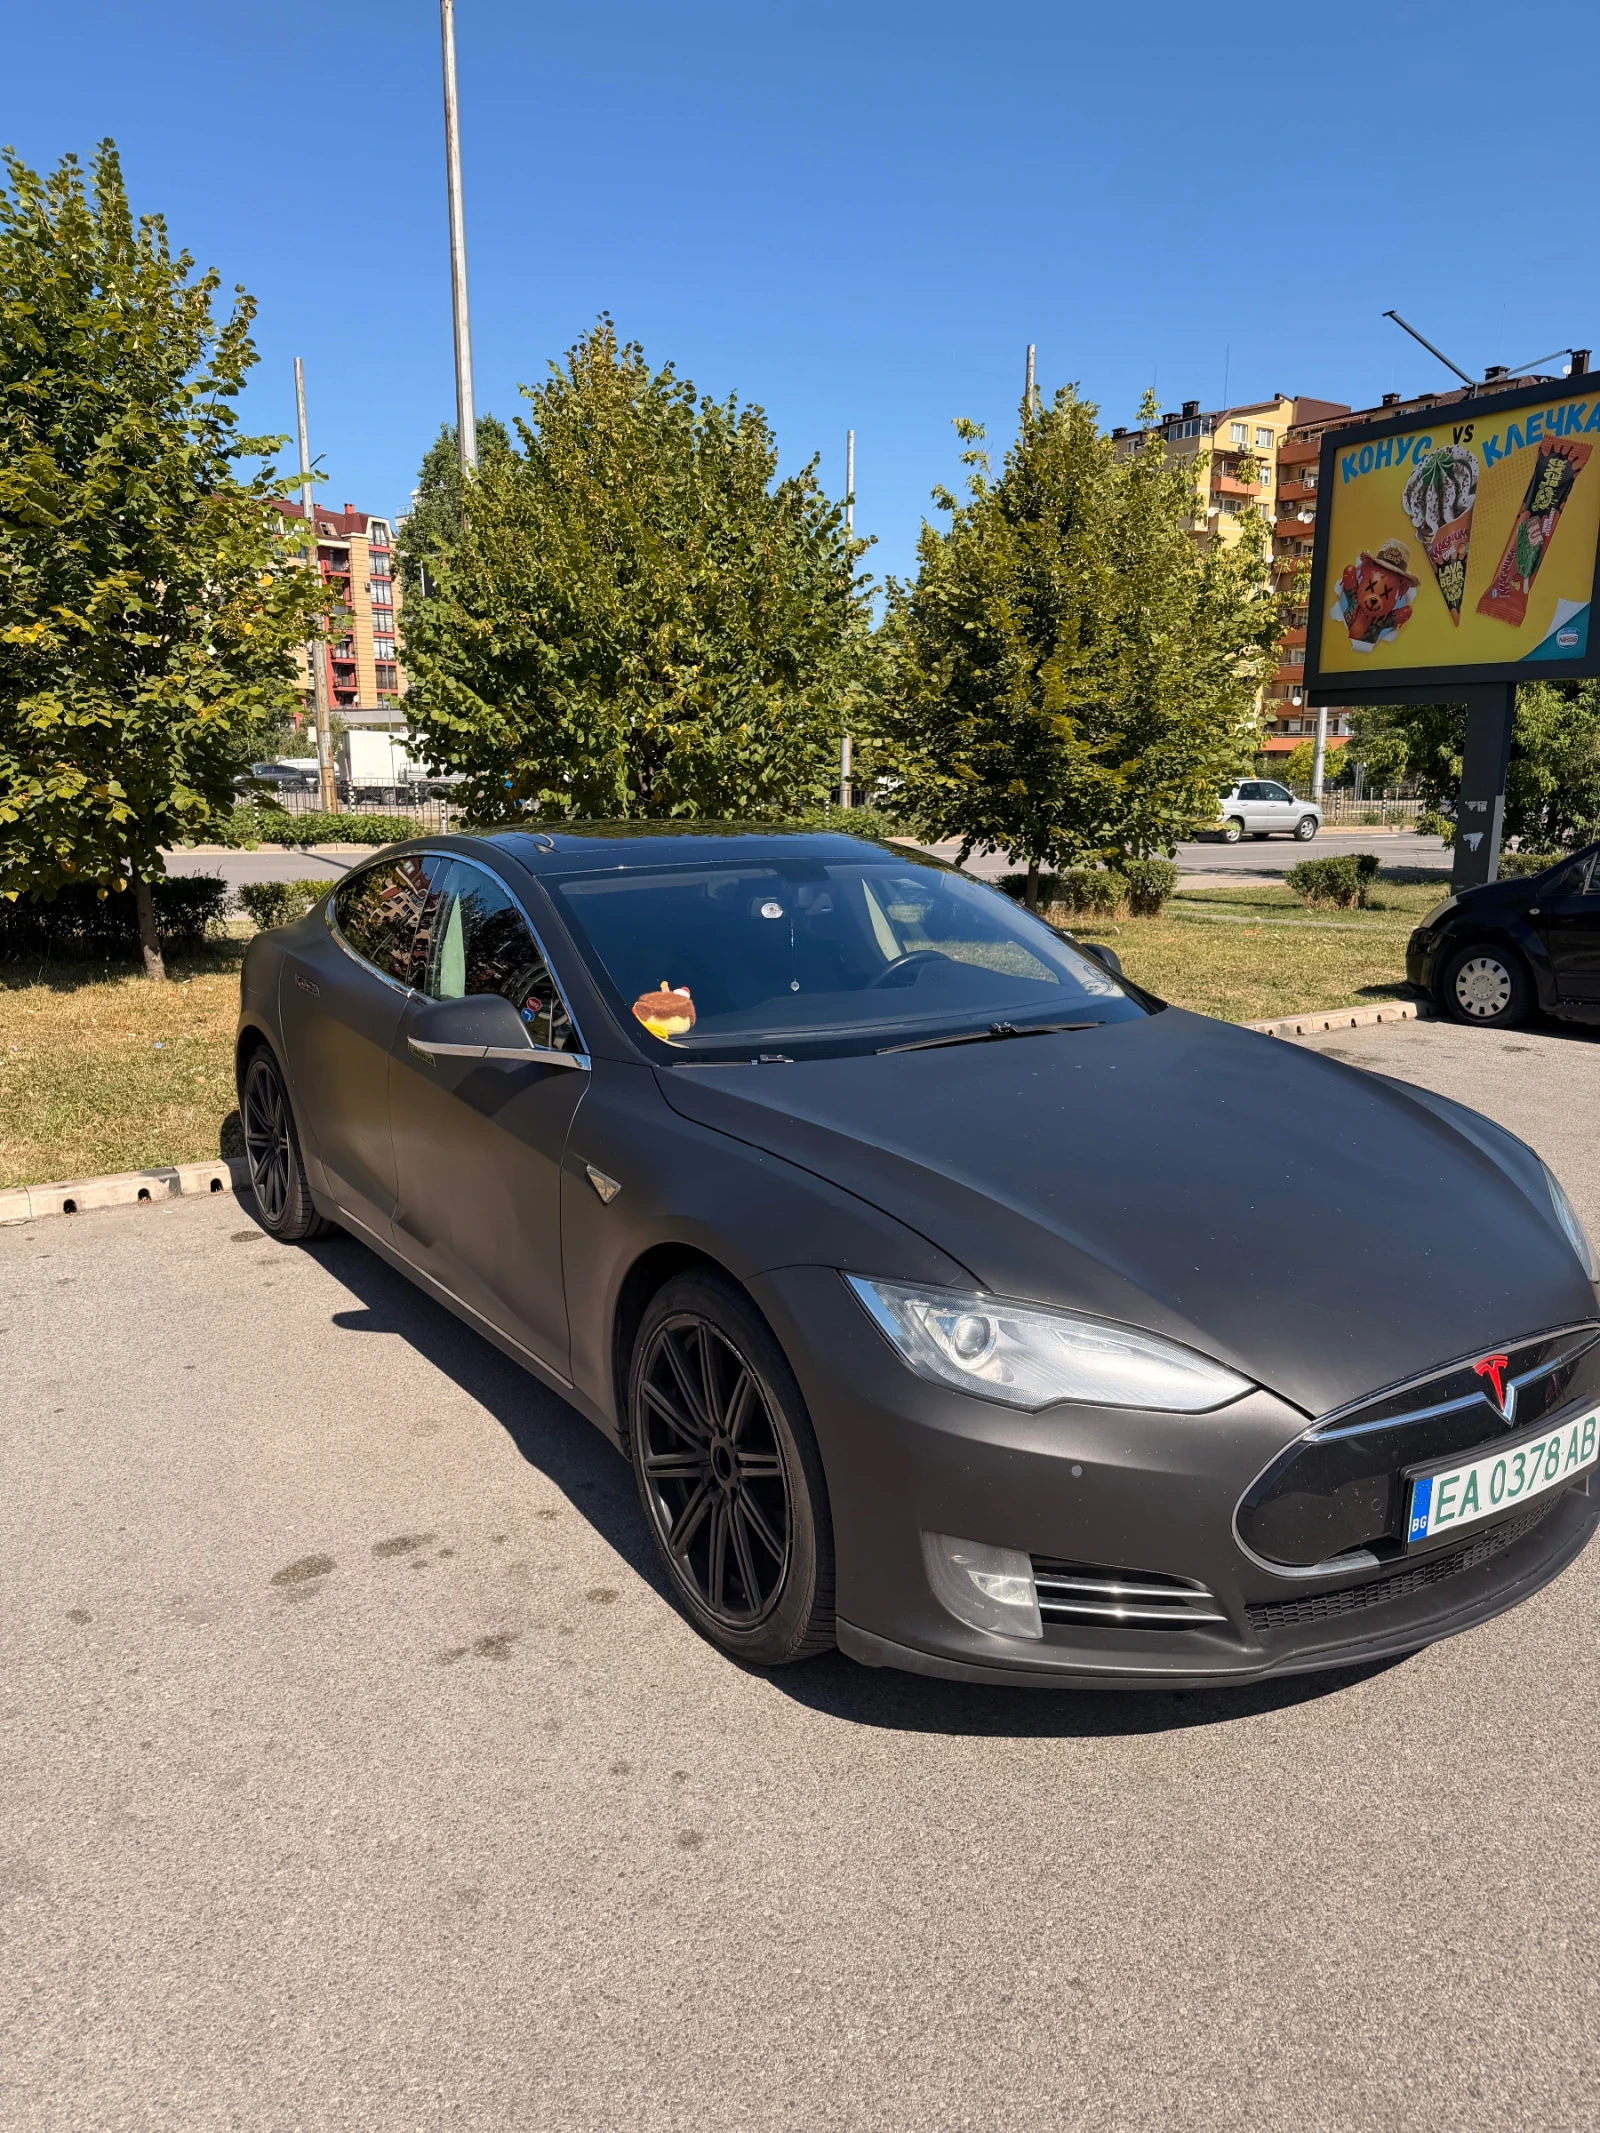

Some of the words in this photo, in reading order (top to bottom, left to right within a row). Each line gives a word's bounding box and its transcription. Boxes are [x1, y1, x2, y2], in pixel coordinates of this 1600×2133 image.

[1452, 424, 1475, 445] VS
[1481, 401, 1600, 469] КЛЕЧКА
[1341, 435, 1433, 485] КОНУС
[1539, 457, 1560, 488] LAVA
[1549, 459, 1568, 488] BEAR
[1429, 528, 1469, 562] MAGNUM
[1438, 560, 1463, 579] LAVA
[1440, 571, 1465, 588] BEAR
[1433, 1469, 1480, 1526] EA
[1489, 1436, 1561, 1505] 0378
[1563, 1416, 1597, 1473] AB
[1411, 1514, 1428, 1533] BG
